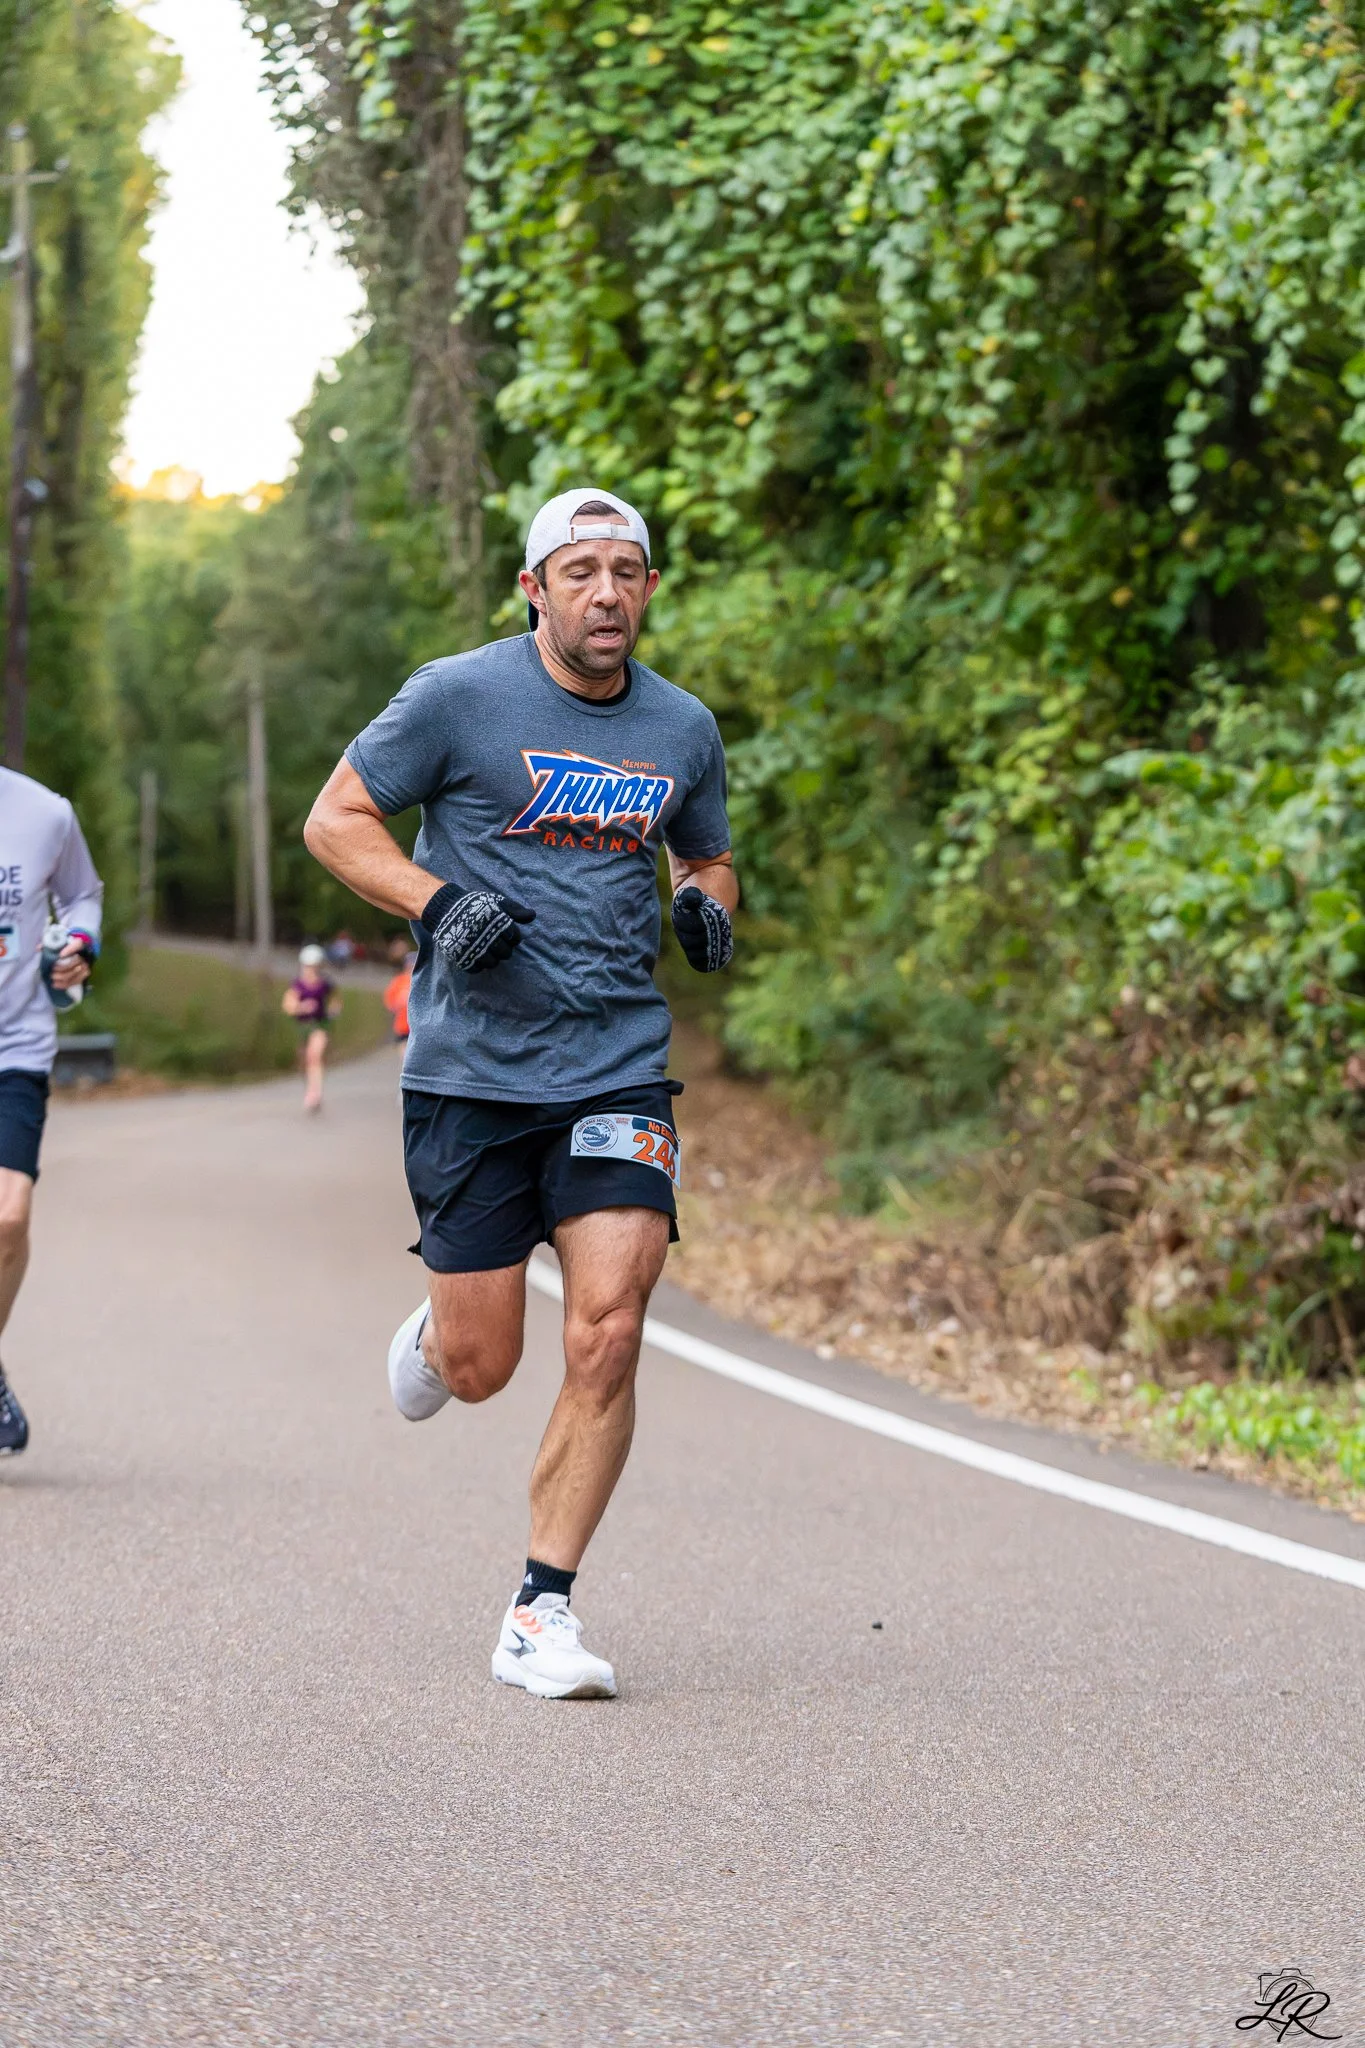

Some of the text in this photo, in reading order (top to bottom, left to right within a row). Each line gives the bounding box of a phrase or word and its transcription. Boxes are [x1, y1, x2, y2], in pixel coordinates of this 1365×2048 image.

[621, 759, 657, 770] MEMPHIS
[506, 751, 672, 839] THUNDER
[543, 831, 639, 853] RACING
[0, 889, 23, 906] IS
